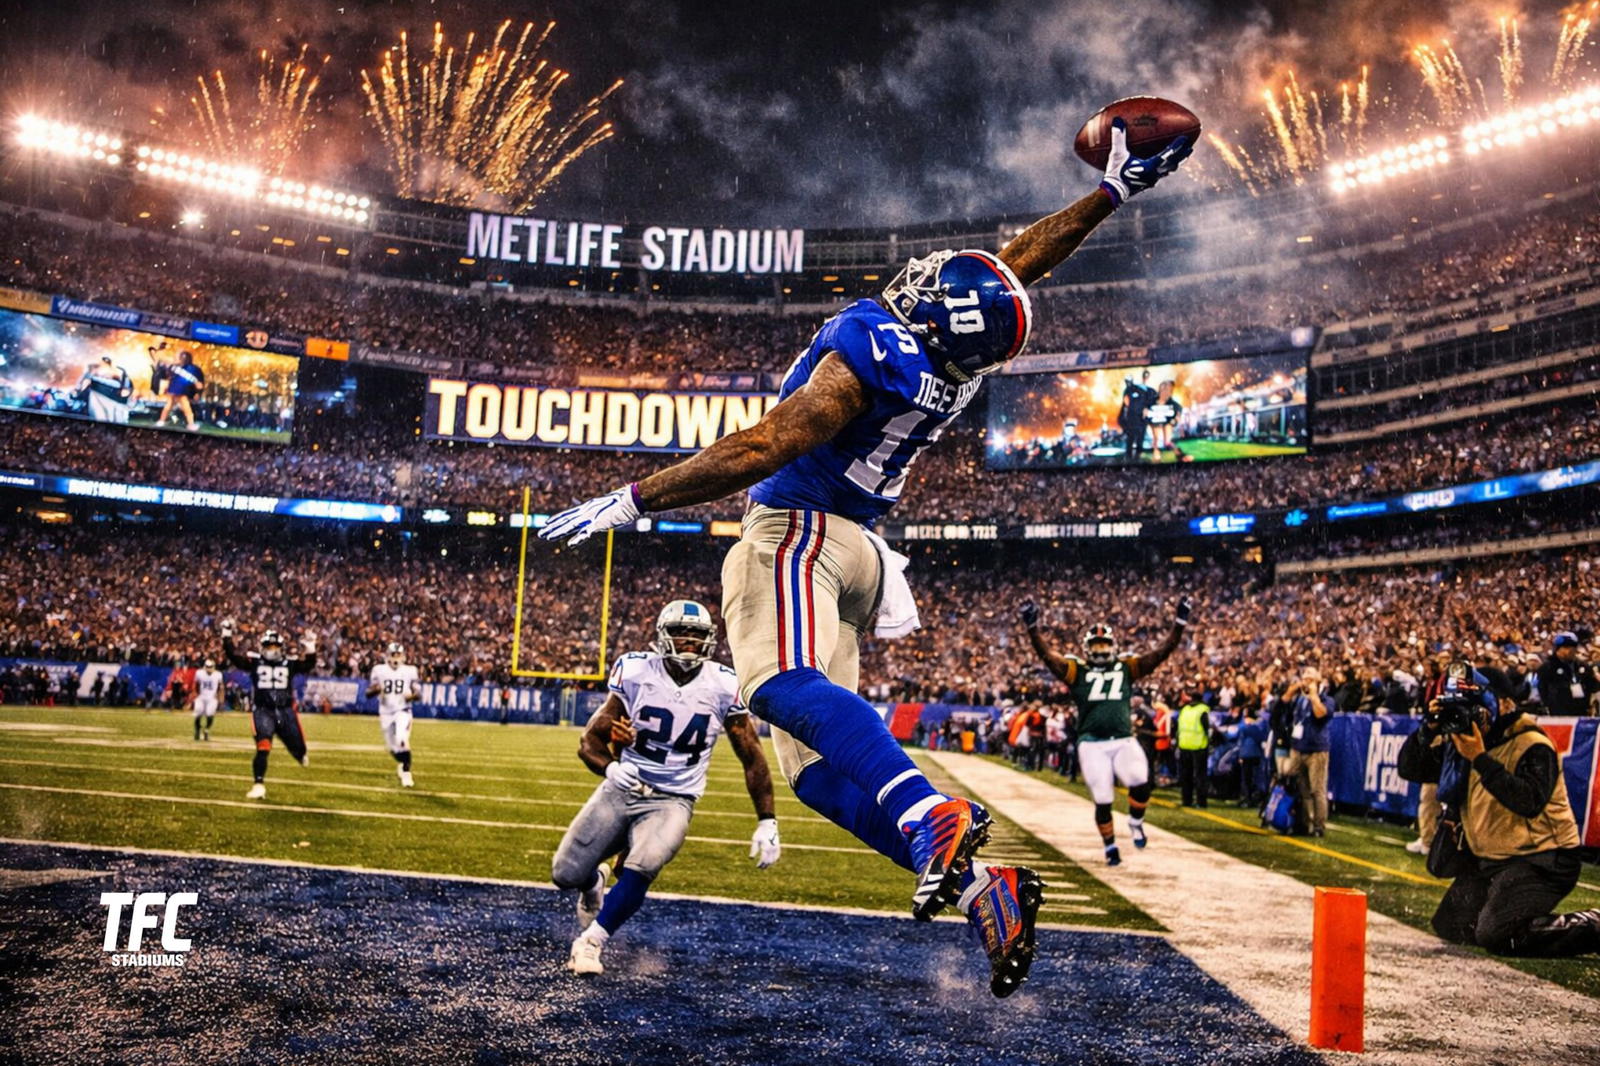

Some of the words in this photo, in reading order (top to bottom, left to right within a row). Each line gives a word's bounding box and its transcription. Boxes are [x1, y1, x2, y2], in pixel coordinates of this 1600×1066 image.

[467, 212, 623, 269] METLIFE
[641, 226, 804, 273] STADIUM
[429, 378, 779, 448] TOUCHDOWN
[257, 665, 289, 690] 29
[634, 705, 711, 766] 24
